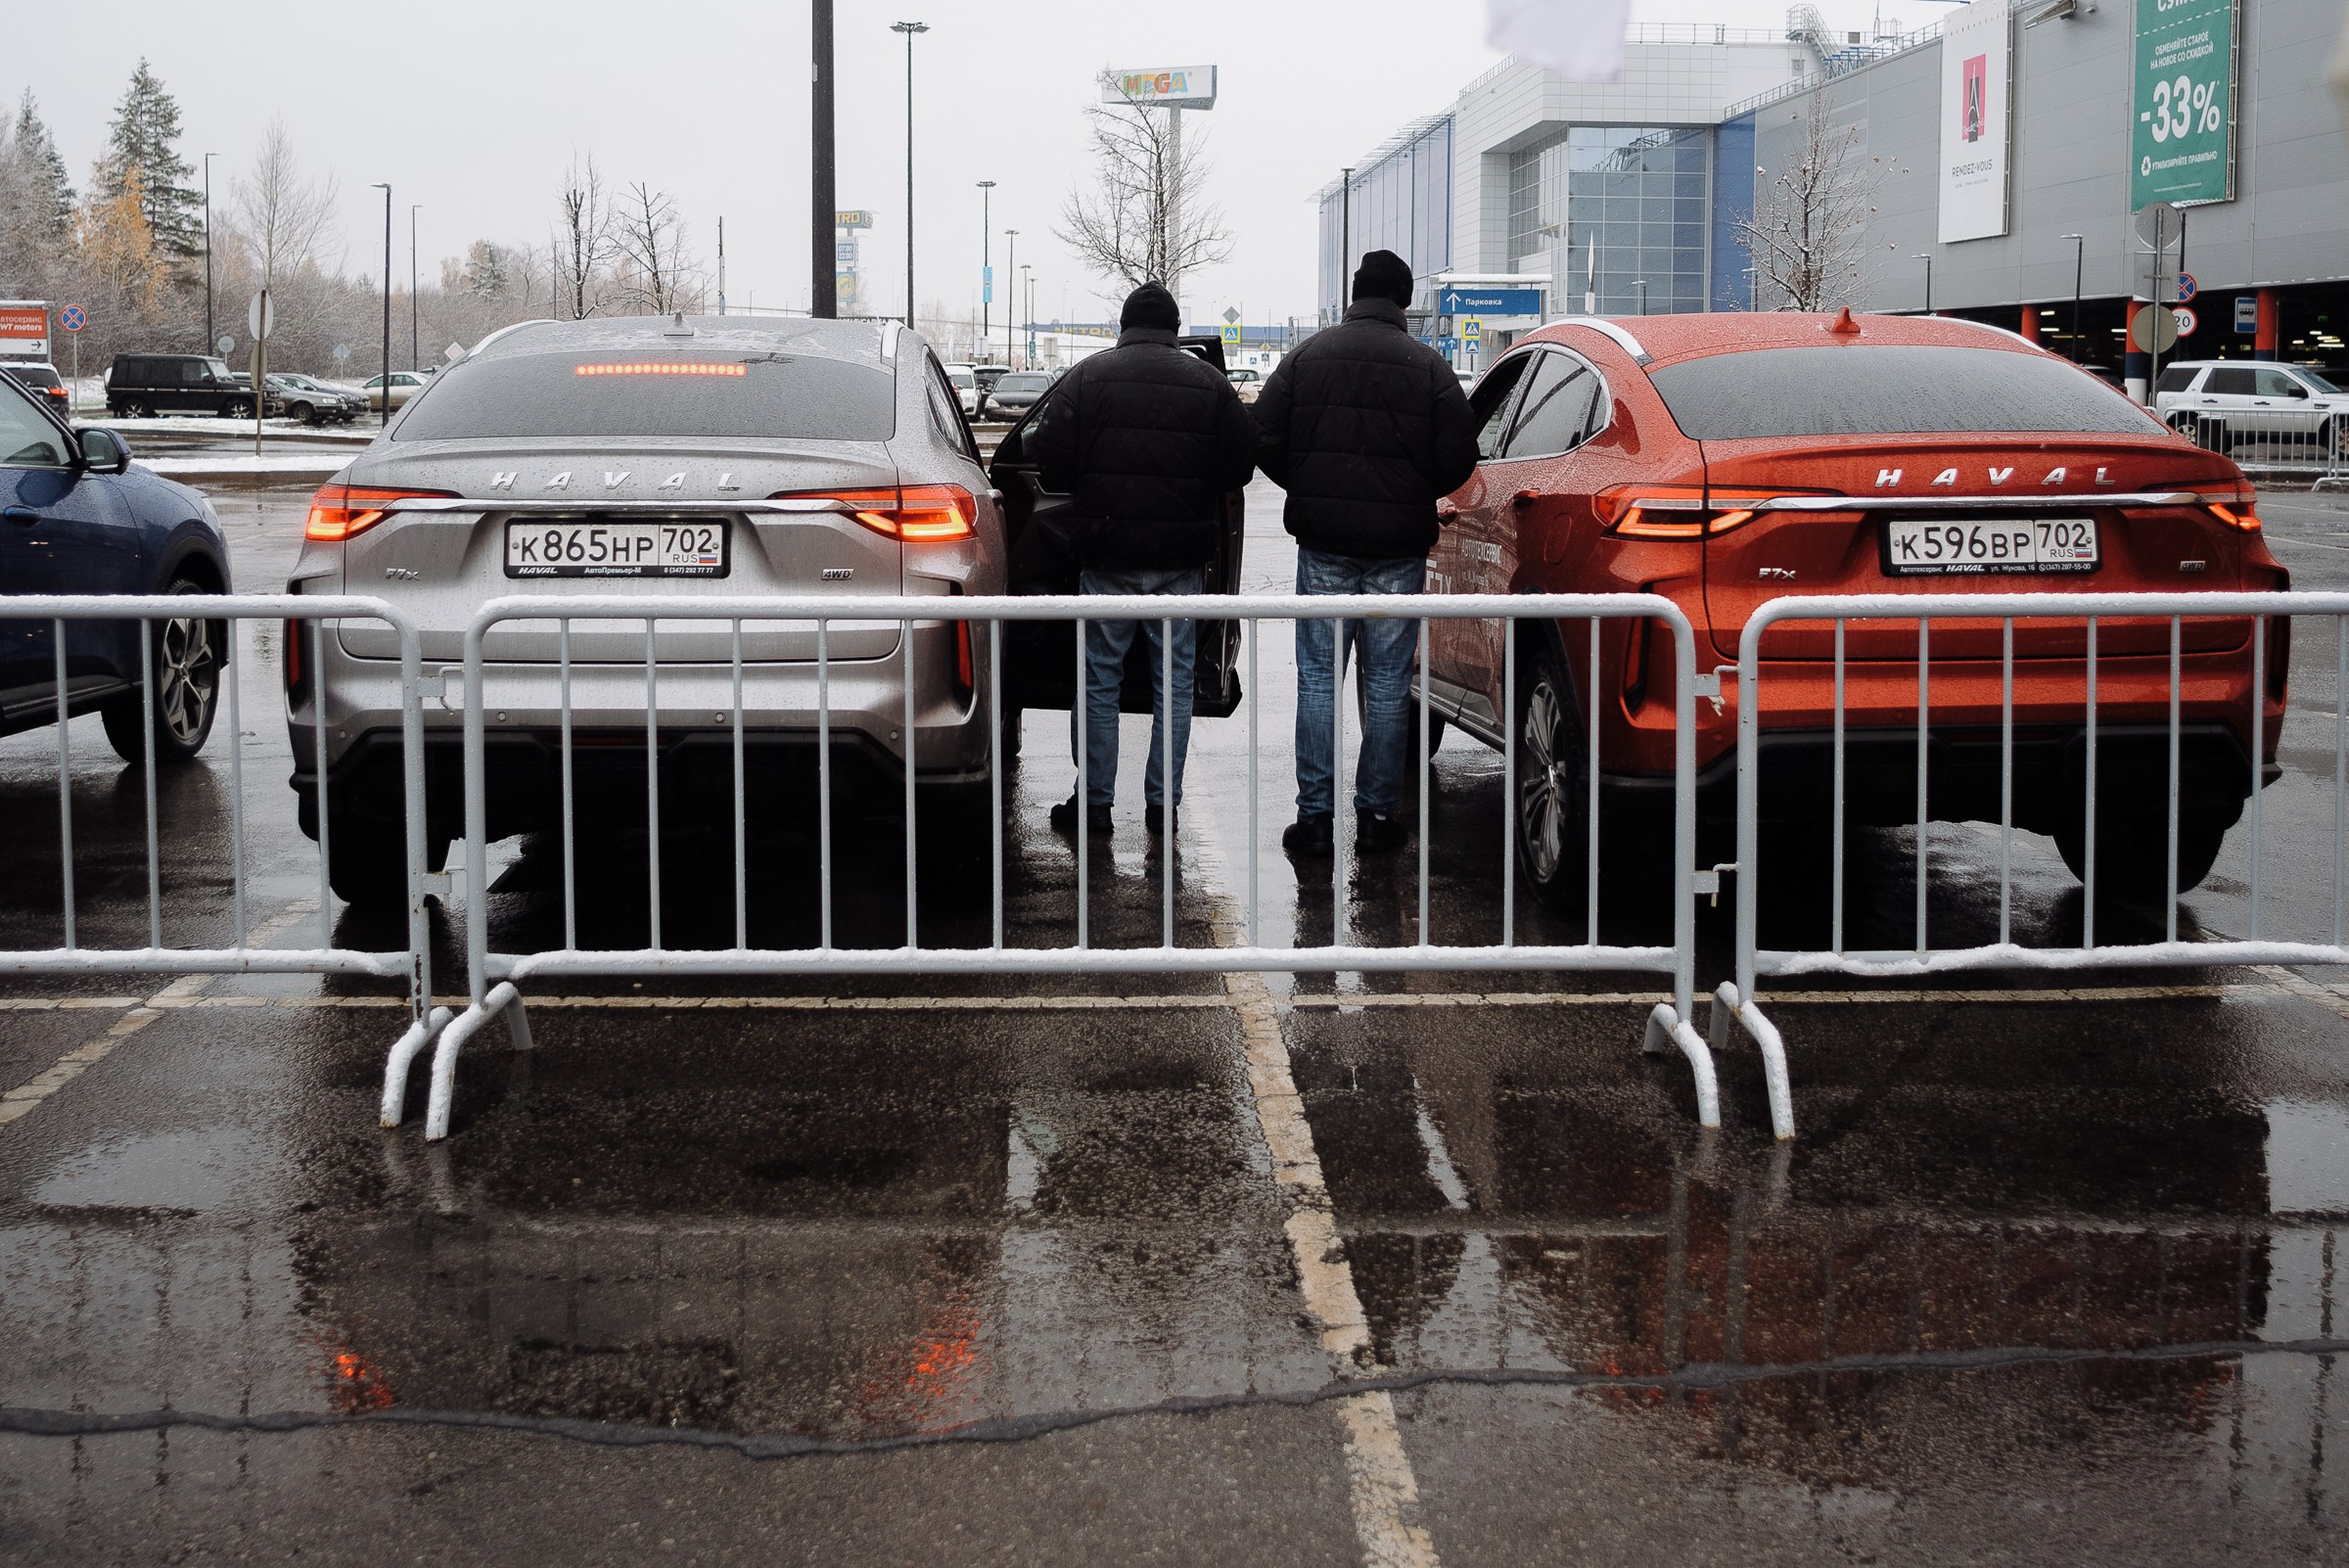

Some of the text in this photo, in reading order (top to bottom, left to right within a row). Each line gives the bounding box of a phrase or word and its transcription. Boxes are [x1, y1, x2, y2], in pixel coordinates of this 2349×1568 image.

[2188, 31, 2209, 46] СТАРОЕ
[2158, 54, 2177, 68] НОВОЕ
[2178, 51, 2186, 62] СО
[2186, 41, 2214, 60] СКИДКОЙ
[2188, 150, 2218, 164] ПРАВИЛЬНО
[1952, 159, 1993, 177] RENDEZ-VOUS
[490, 472, 741, 490] HAVAL
[1874, 467, 2115, 487] HAVAL
[521, 529, 713, 562] К865НР 702
[1901, 523, 2087, 560] К596ВР 702
[672, 554, 698, 563] RUS
[2050, 548, 2074, 558] RUS
[584, 567, 642, 576] АвтоПремьер-М
[824, 570, 852, 578] 4WD
